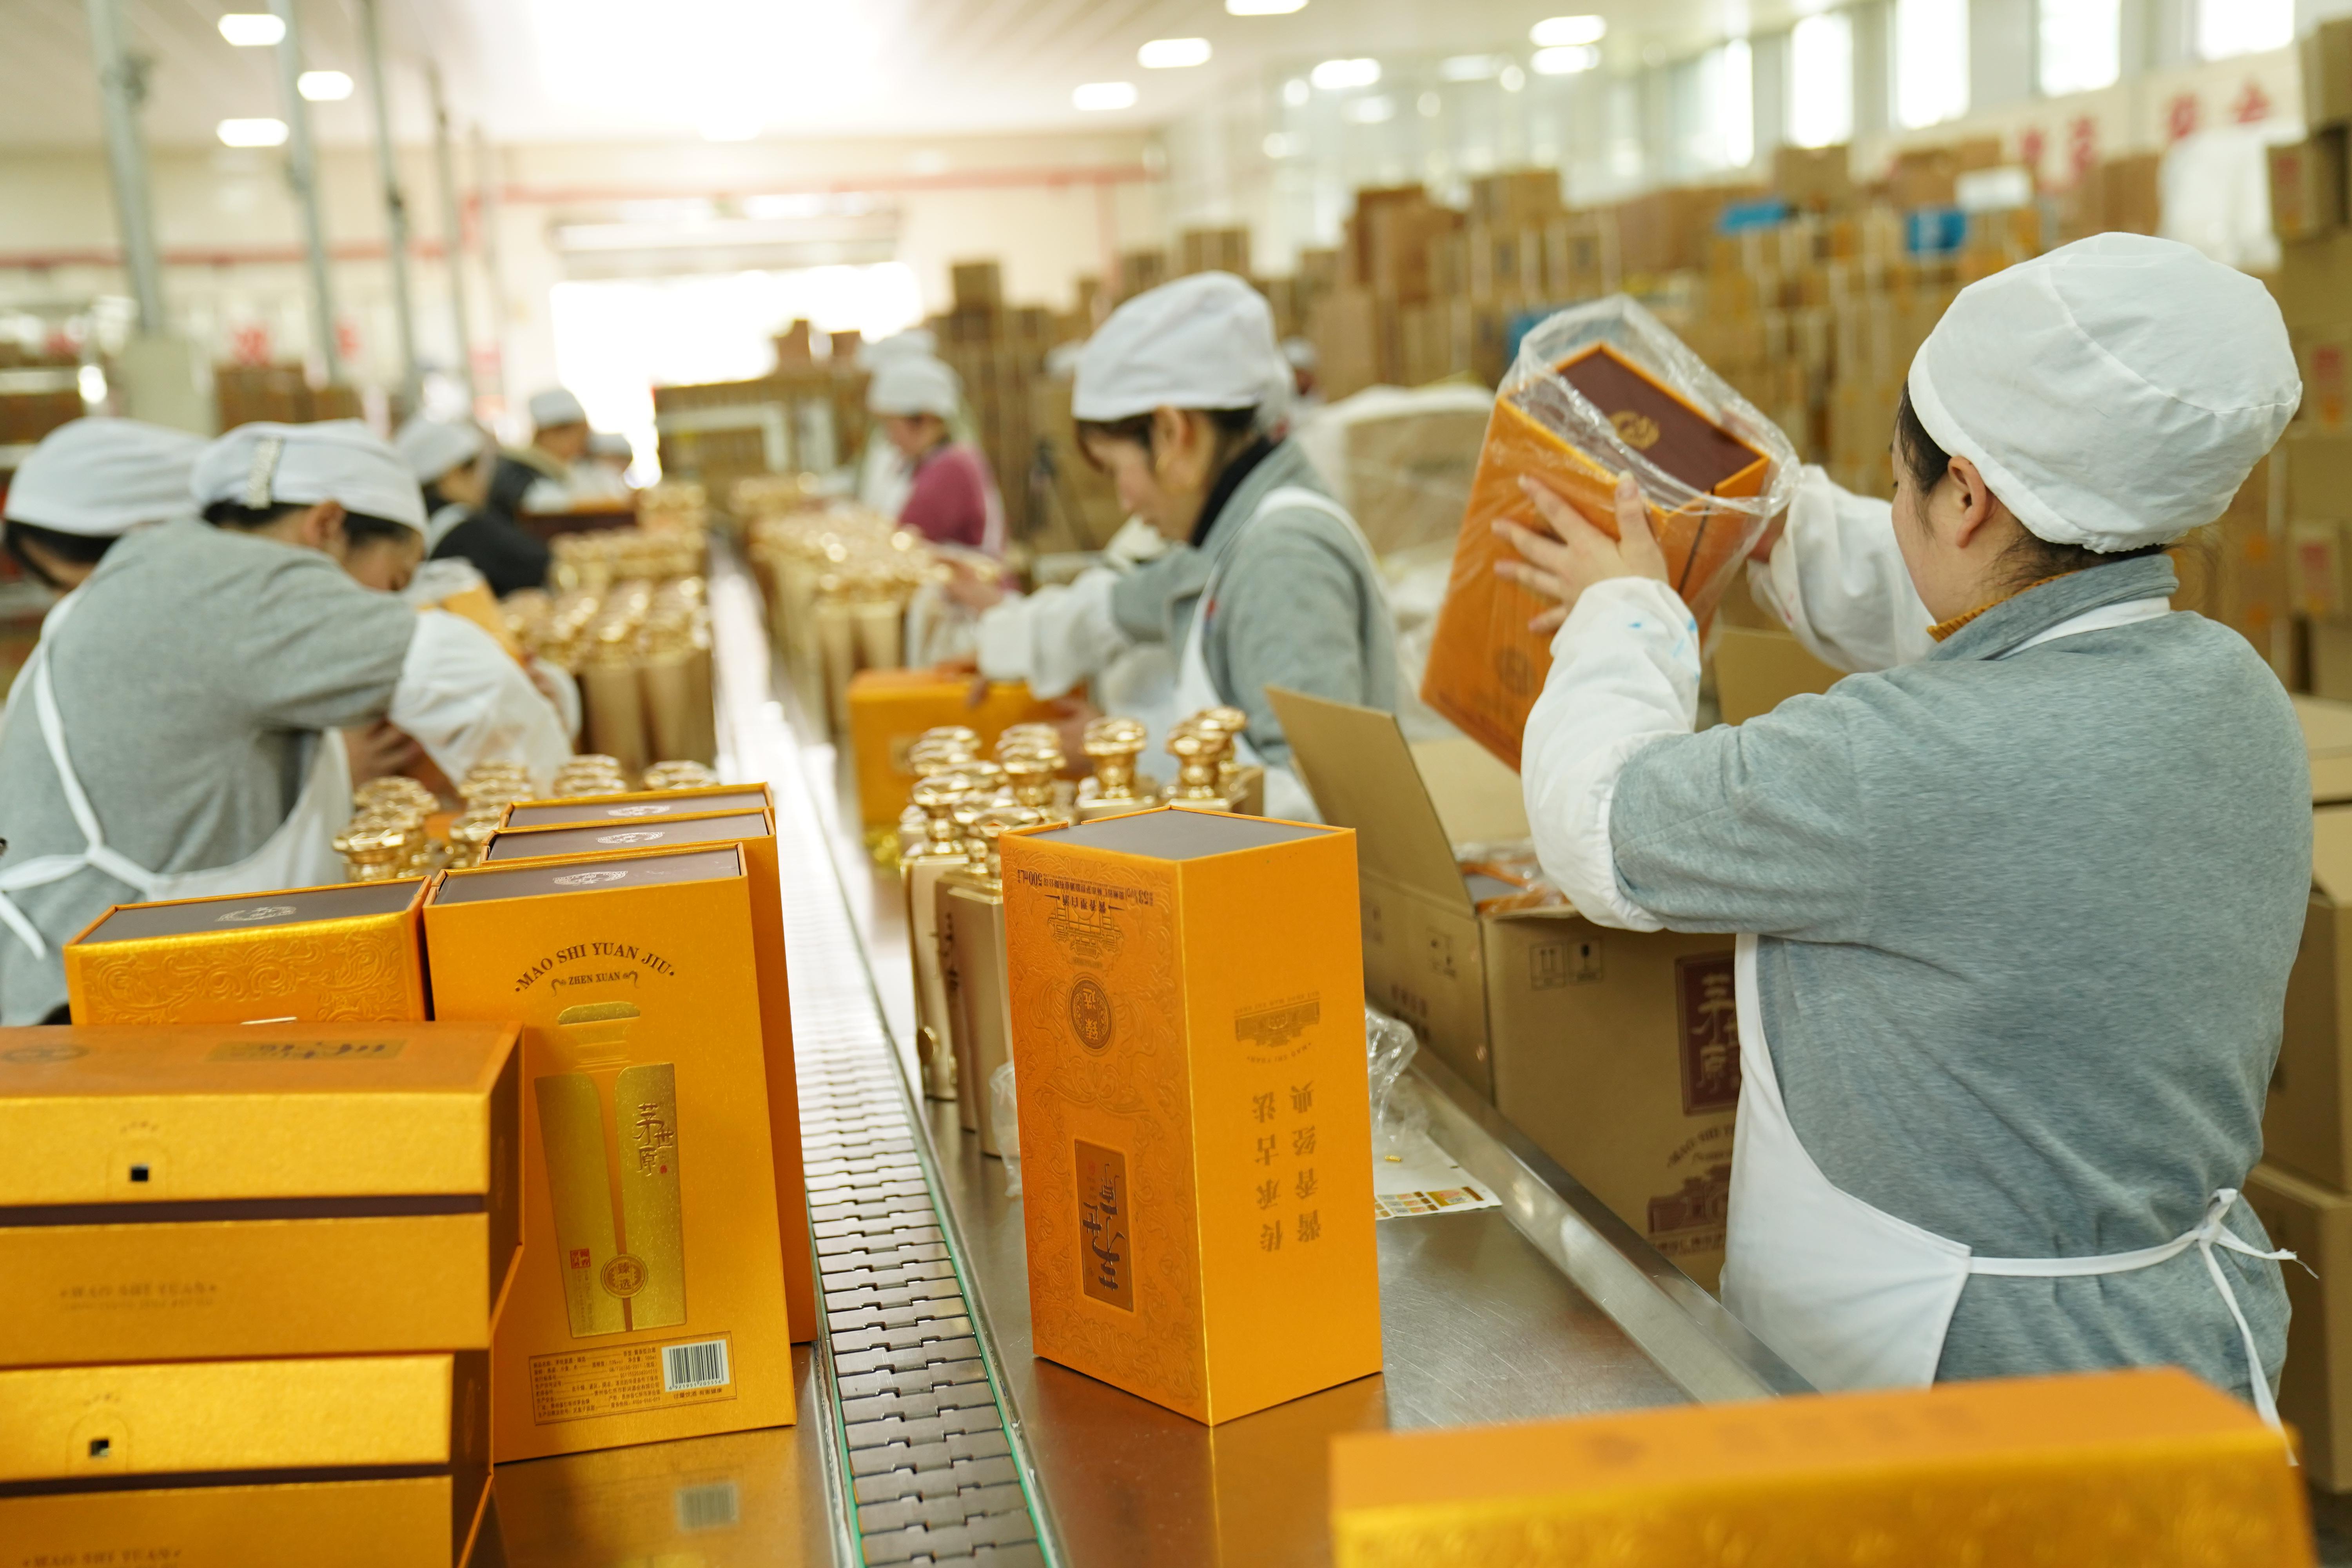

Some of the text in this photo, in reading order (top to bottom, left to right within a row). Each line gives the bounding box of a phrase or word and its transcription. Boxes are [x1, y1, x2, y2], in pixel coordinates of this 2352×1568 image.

[1063, 893, 1106, 913] 酱香型白酒
[518, 942, 670, 990] MAO SHI YUAN JIU
[568, 971, 621, 985] ZHEN XUAN
[1082, 987, 1099, 1041] 臻选
[633, 1103, 674, 1176] 茅世原
[1289, 1080, 1321, 1243] 酱香经典
[1251, 1091, 1284, 1252] 传承古法
[1082, 1164, 1125, 1291] 茅世原
[617, 1261, 632, 1290] 臻选
